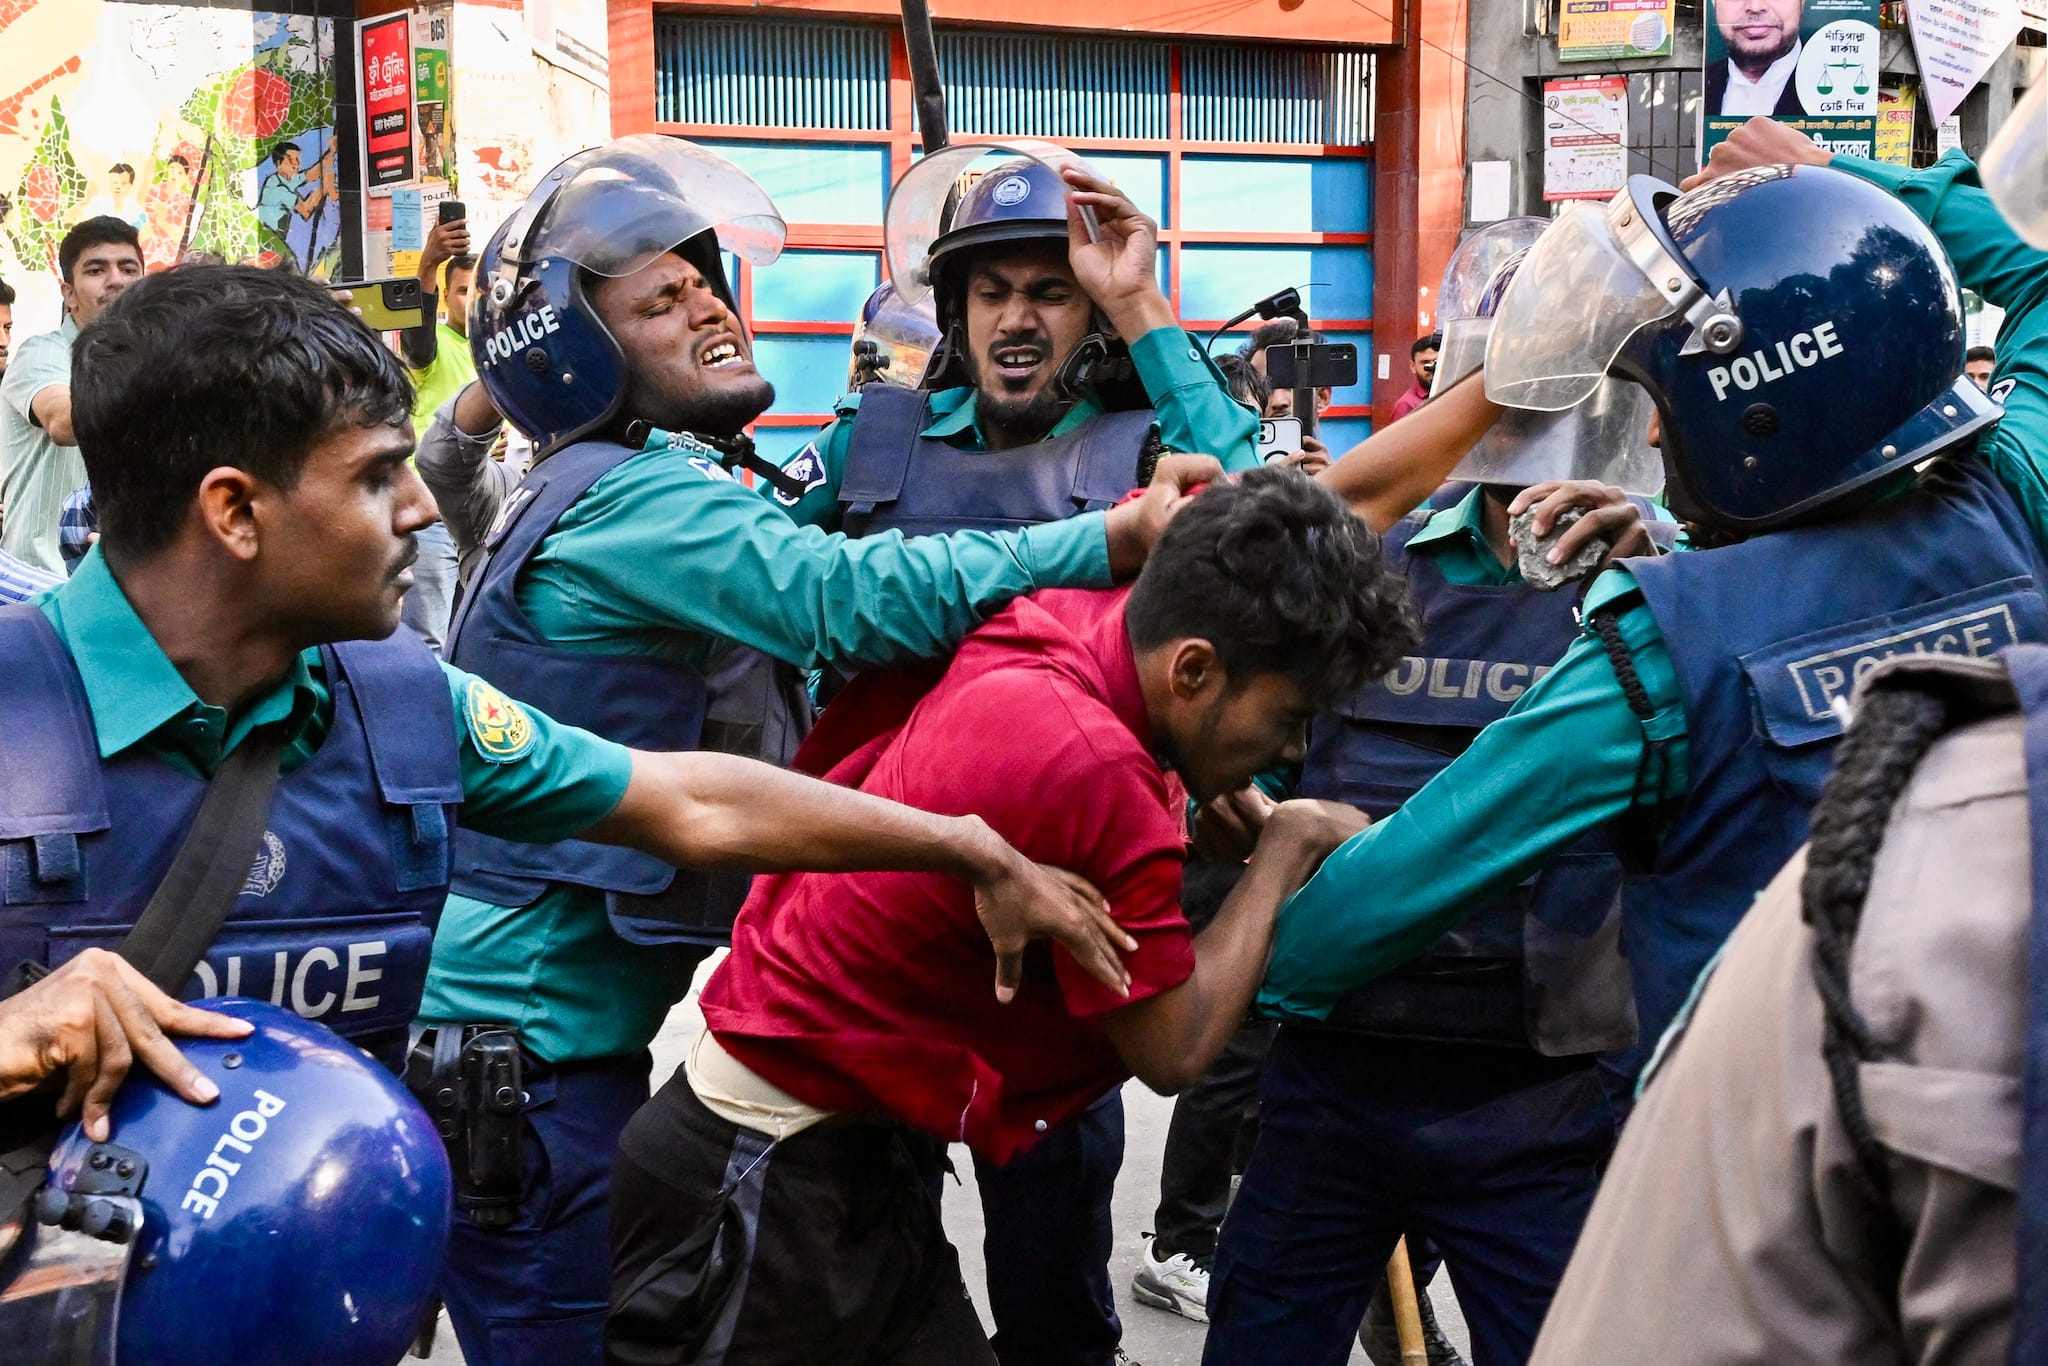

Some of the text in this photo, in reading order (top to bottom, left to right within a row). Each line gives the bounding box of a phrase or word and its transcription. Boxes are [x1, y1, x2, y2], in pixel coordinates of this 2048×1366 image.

[431, 18, 444, 41] BCS
[1825, 29, 1865, 42] দাঁড়িপাল্লা
[1830, 43, 1859, 53] মার্কায়
[1820, 100, 1842, 111] ভোট
[1847, 98, 1865, 111] দিন
[423, 191, 450, 201] TO-LET
[486, 304, 560, 365] POLICE
[1707, 320, 1844, 401] POLICE
[181, 1089, 286, 1219] POLICE
